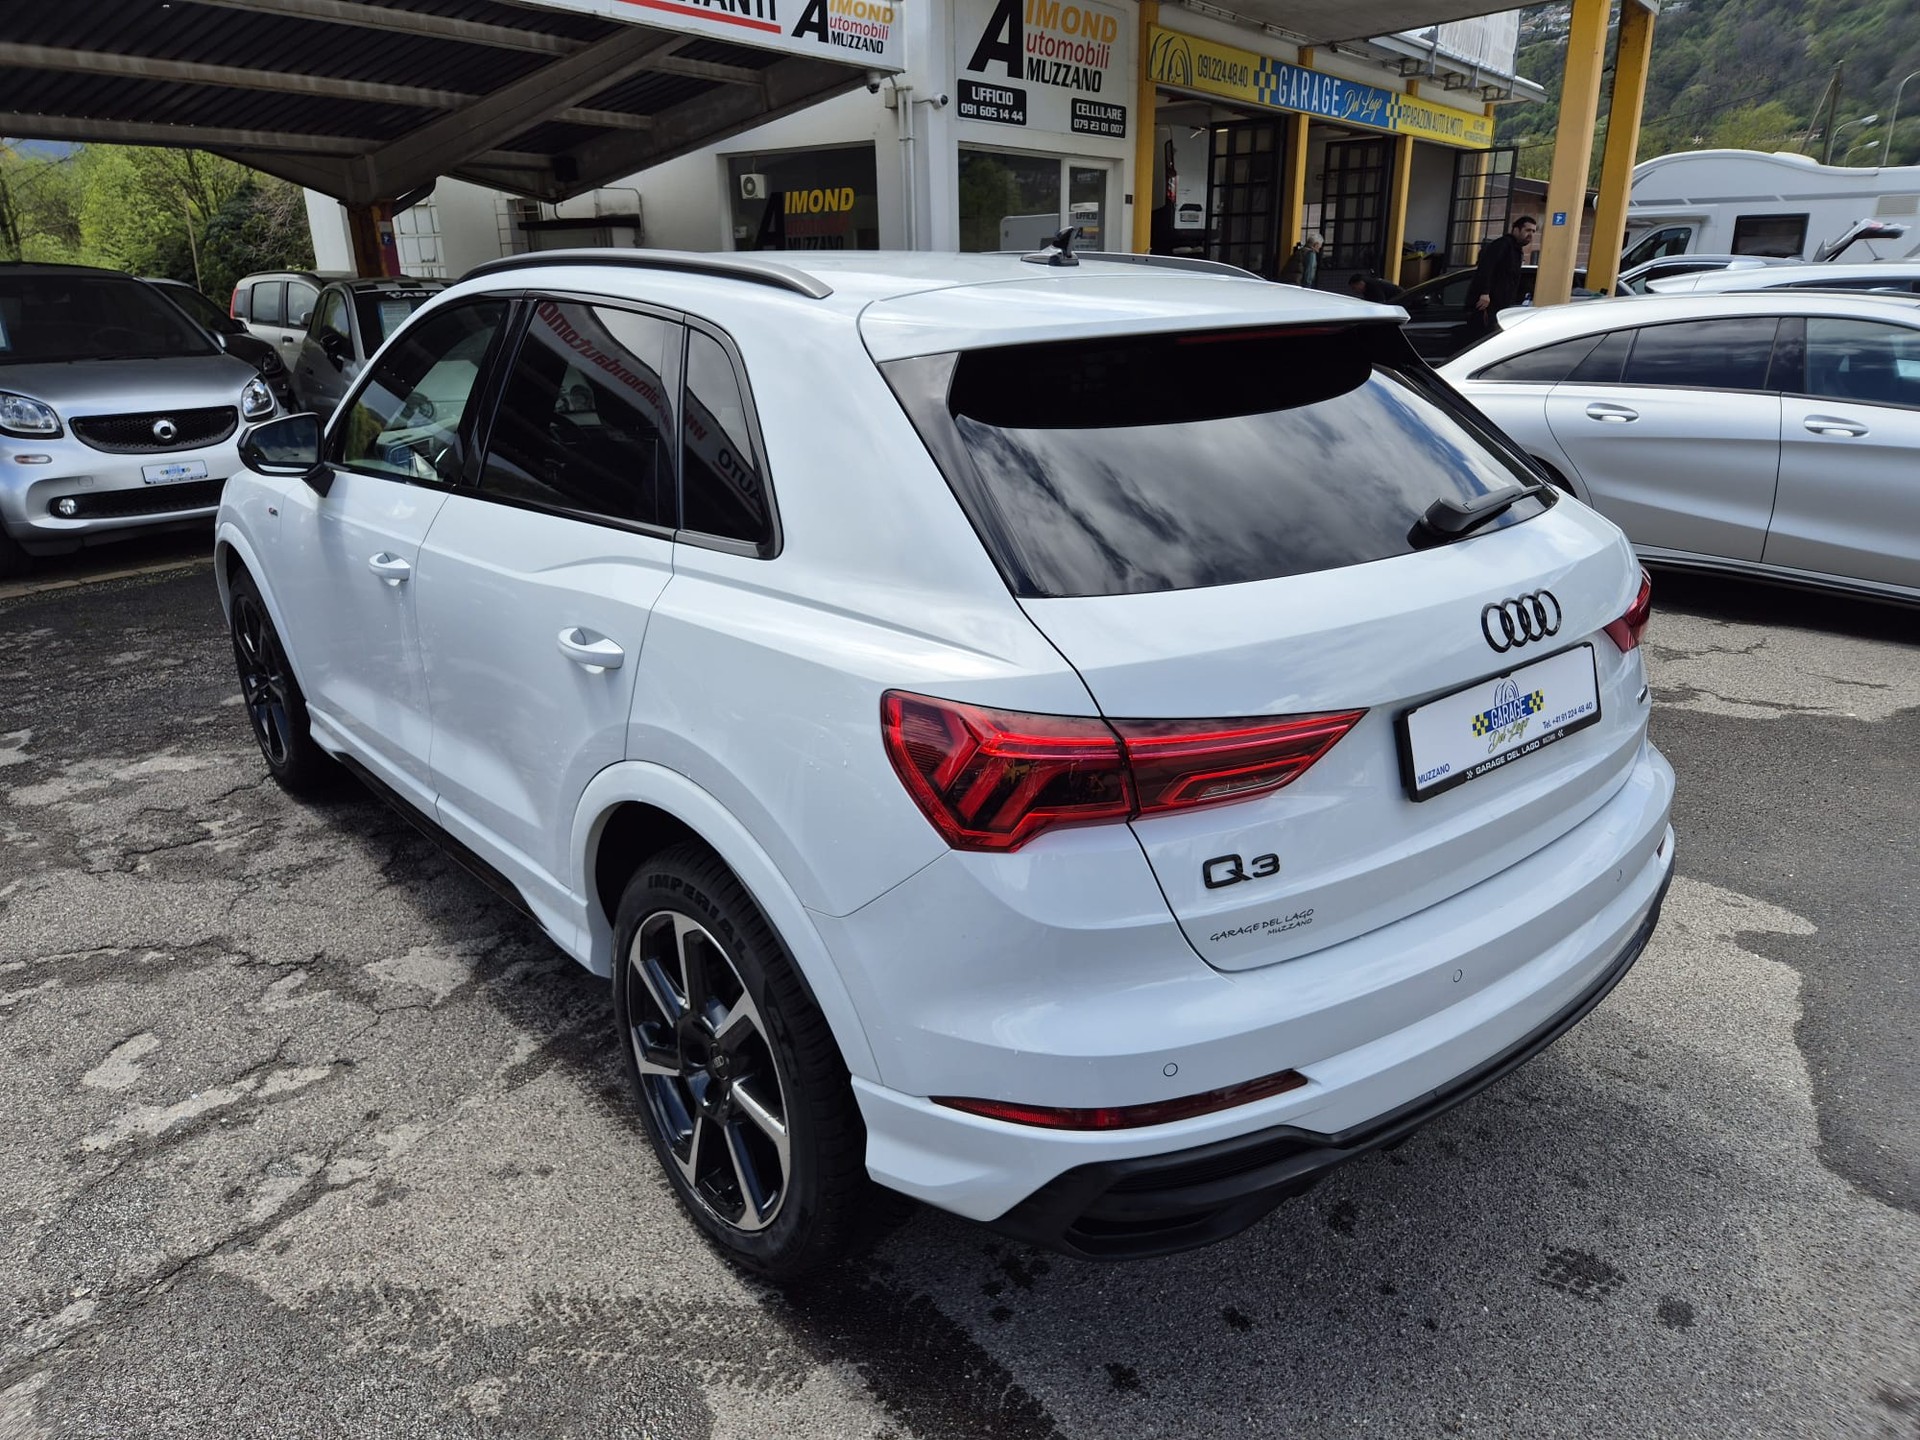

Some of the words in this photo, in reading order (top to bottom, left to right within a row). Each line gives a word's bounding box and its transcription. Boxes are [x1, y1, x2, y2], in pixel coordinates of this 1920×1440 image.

[830, 30, 884, 54] MUZZANO
[1026, 57, 1102, 93] MUZZANO
[972, 86, 1013, 105] UFFICIO
[1278, 65, 1341, 116] GARAGE
[961, 102, 977, 115] 091
[980, 105, 997, 118] 605
[1000, 109, 1009, 120] 14
[1011, 110, 1023, 121] 44
[1076, 102, 1122, 121] CELLULARE
[1491, 698, 1527, 729] GARAGE
[1475, 755, 1506, 775] GARAGE
[1507, 749, 1521, 761] DEL
[1521, 740, 1540, 754] LAGO
[1418, 763, 1451, 784] MUZZANO
[648, 874, 746, 961] IMPERIAL
[1210, 922, 1261, 942] GARAGE
[1262, 917, 1283, 930] DEL
[1284, 908, 1315, 923] LAGO
[1267, 918, 1313, 936] MUZZANO
